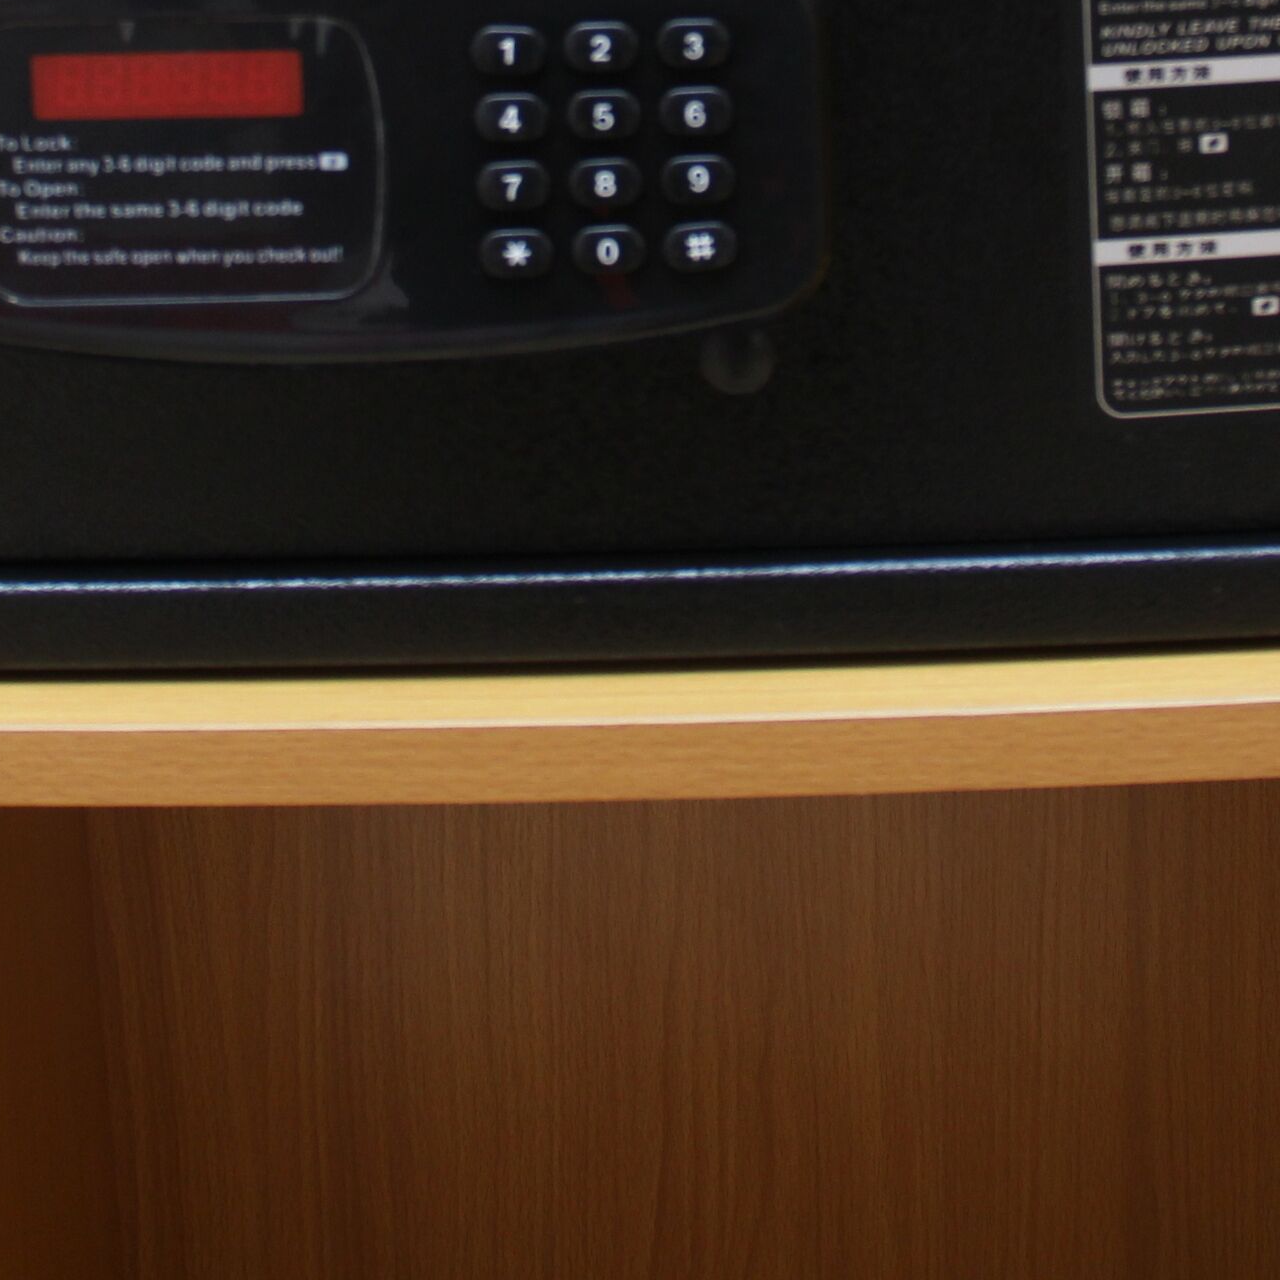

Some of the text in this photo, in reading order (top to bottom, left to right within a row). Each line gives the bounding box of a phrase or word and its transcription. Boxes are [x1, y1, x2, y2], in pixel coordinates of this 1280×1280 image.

[1098, 21, 1173, 41] KINDLY
[1175, 17, 1241, 37] LEAVE
[497, 31, 705, 67] 1 2 3
[1099, 35, 1210, 58] UNLOCKED
[1214, 31, 1272, 51] UPON
[498, 99, 707, 134] 4 5 6
[12, 152, 317, 178] Enter any 3-6 digit code and press
[501, 164, 711, 203] 7 8 9
[14, 197, 304, 221] Enter the same 3-6 digit code
[16, 243, 344, 270] Keep the safe open when you check out!
[596, 237, 620, 266] 0
[684, 232, 716, 262] #
